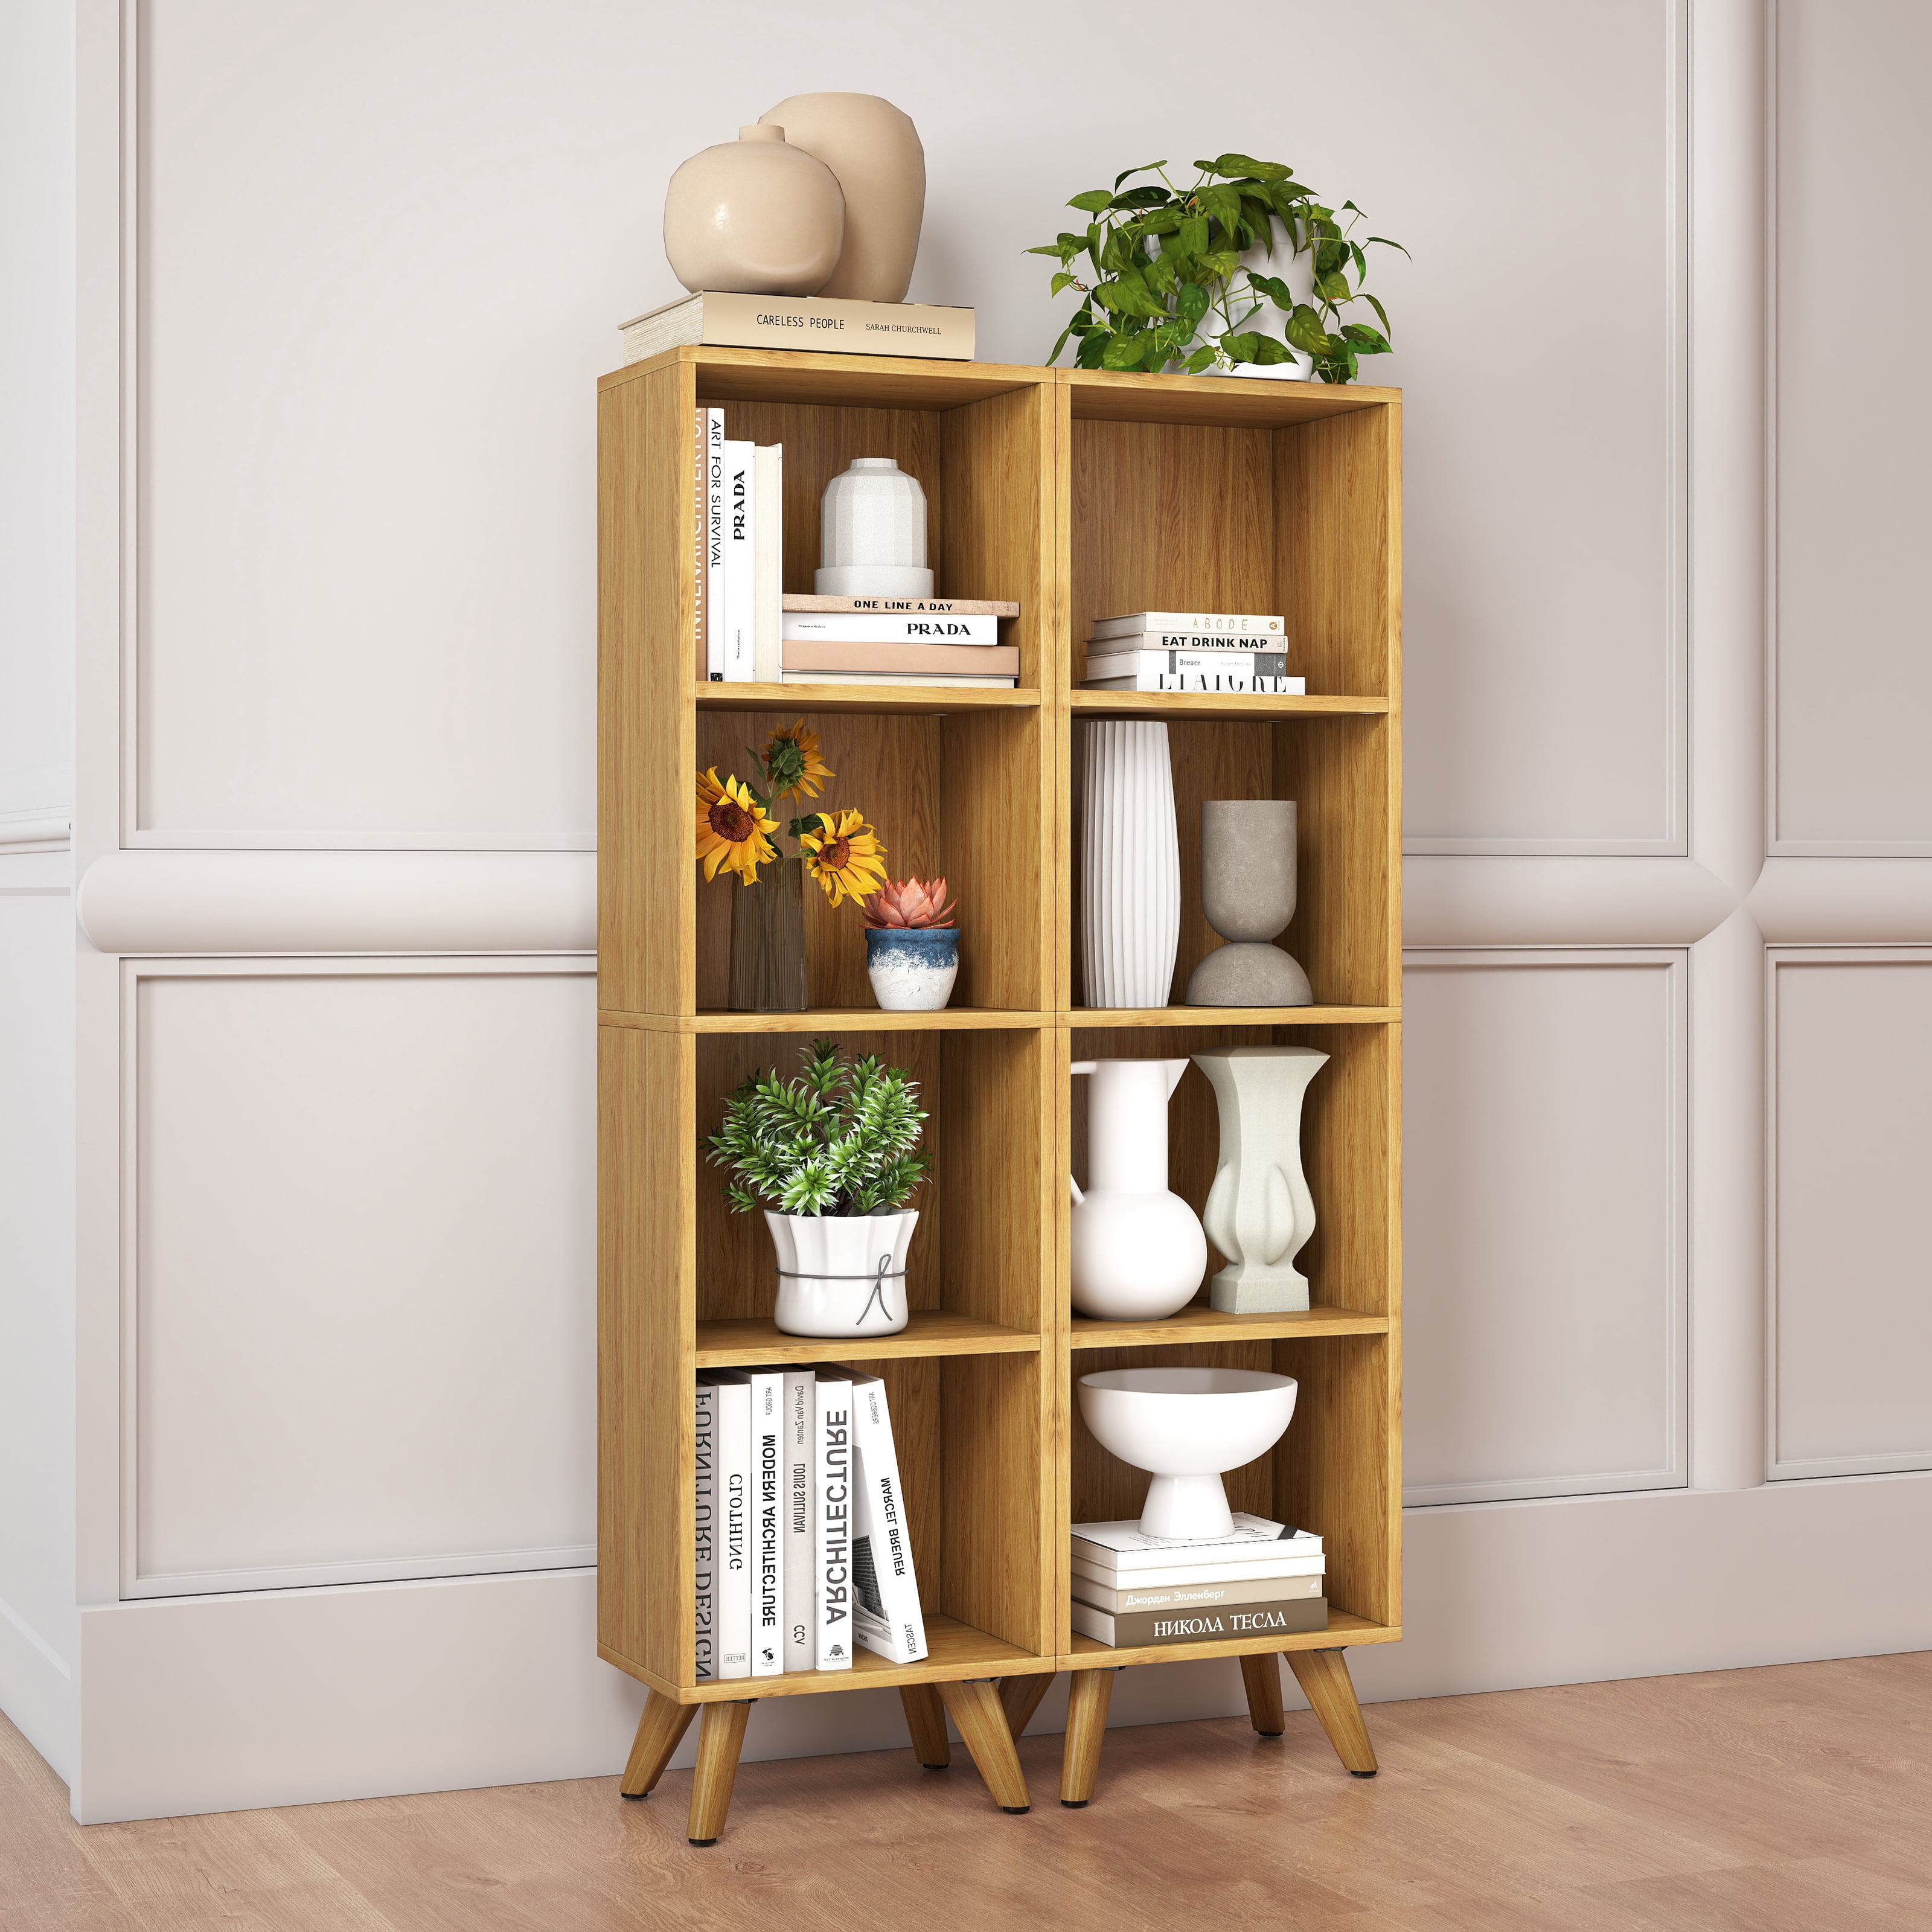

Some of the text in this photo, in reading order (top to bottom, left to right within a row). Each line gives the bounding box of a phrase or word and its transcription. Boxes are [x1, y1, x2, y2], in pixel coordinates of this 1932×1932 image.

[757, 315, 844, 329] CARELESS PEOPLE
[892, 325, 941, 334] CHURCHWELL
[711, 420, 721, 568] ART FOR SURVIVAL
[734, 470, 744, 540] PRADA
[854, 601, 878, 609] ONE
[907, 624, 971, 635] PRADA
[1194, 618, 1247, 630] ABODE
[1162, 636, 1267, 648] EAT DRINK NAP
[1126, 1589, 1225, 1607] Джордан Элленберг
[1154, 1611, 1287, 1636] НИКОЛА ТЕСЛА
